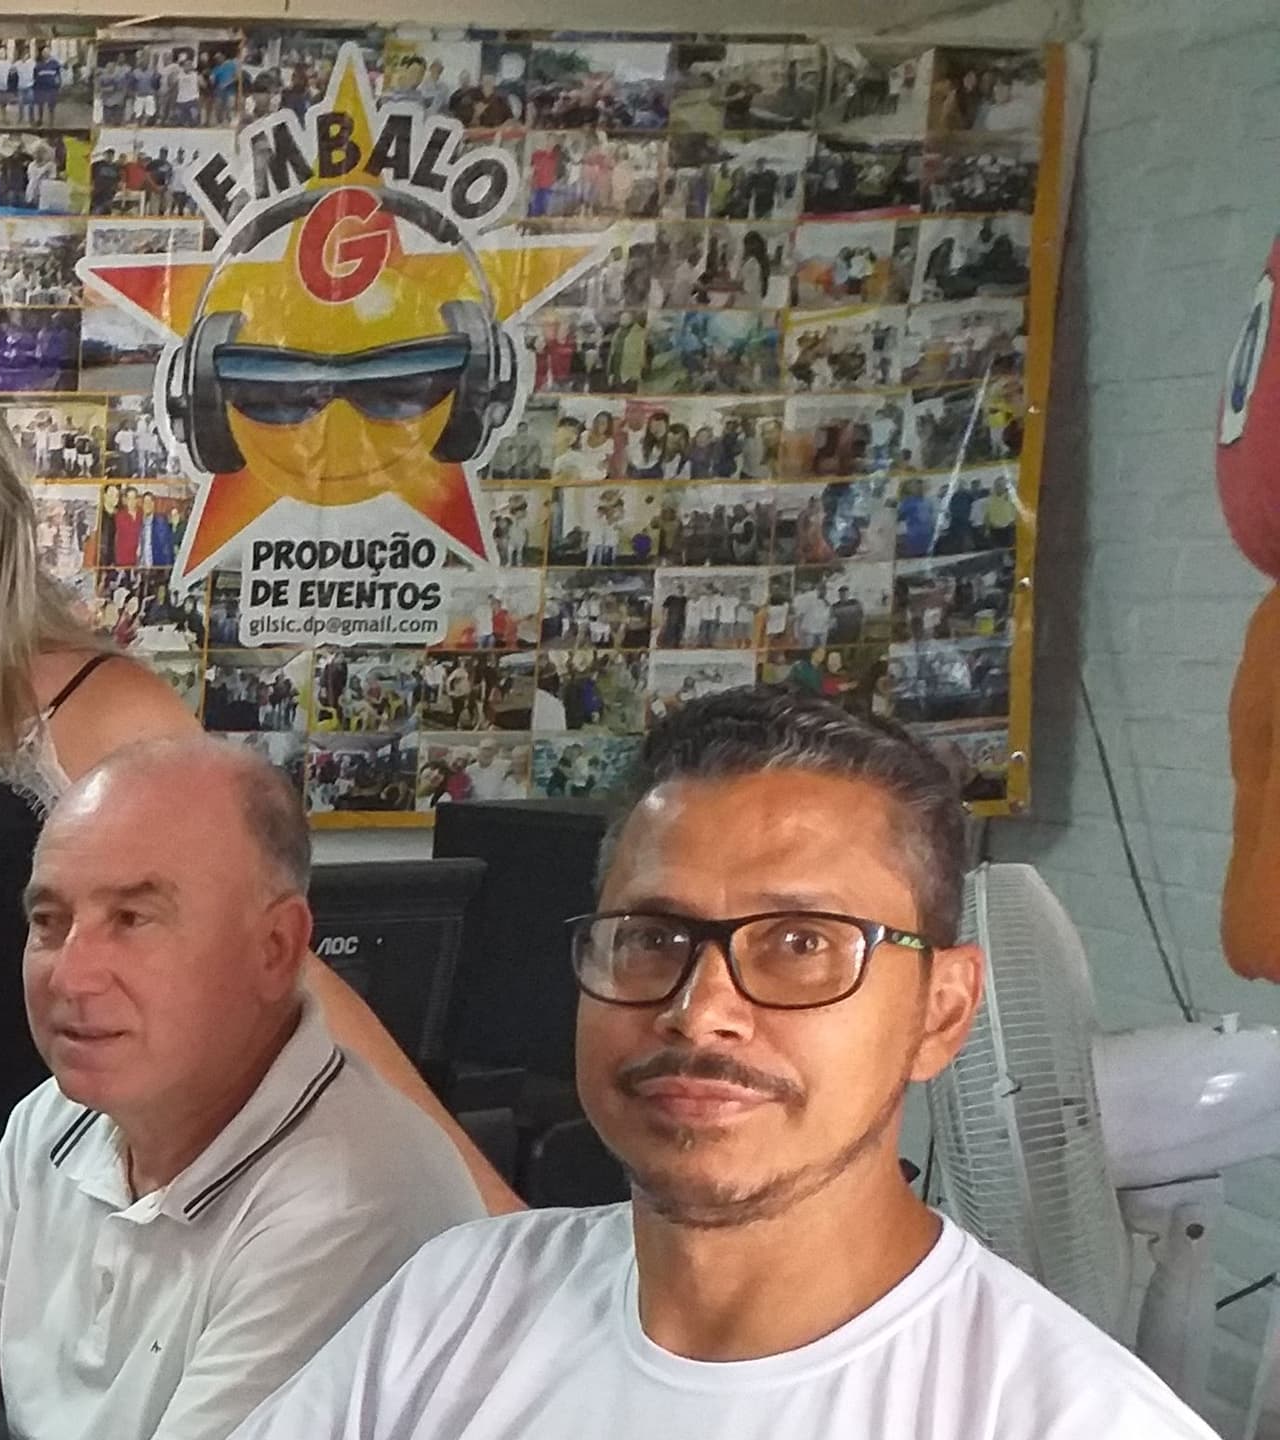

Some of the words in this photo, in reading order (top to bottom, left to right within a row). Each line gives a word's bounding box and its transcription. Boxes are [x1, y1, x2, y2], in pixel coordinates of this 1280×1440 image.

[194, 112, 508, 225] EMBALO
[250, 580, 289, 607] DE
[299, 580, 441, 610] EVENTOS
[316, 936, 359, 956] AOC
